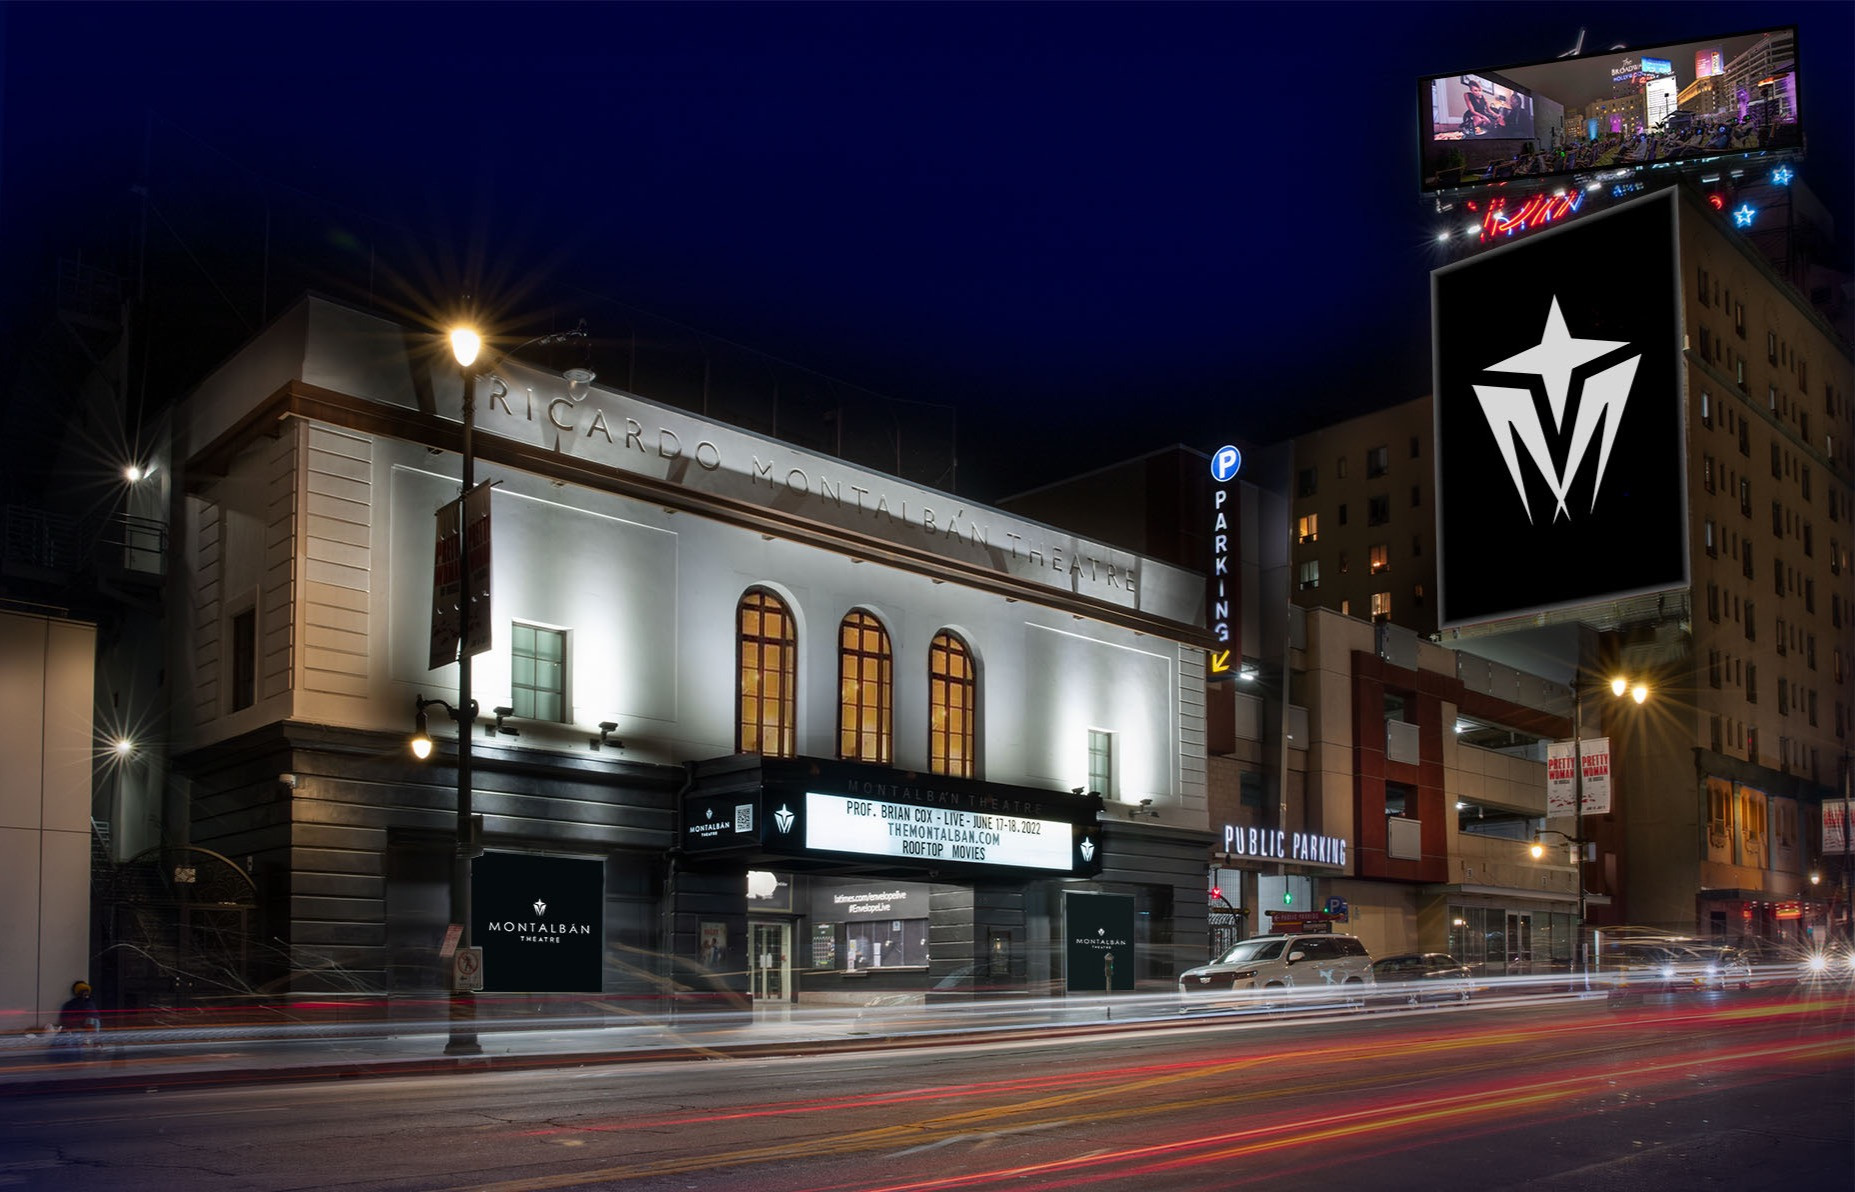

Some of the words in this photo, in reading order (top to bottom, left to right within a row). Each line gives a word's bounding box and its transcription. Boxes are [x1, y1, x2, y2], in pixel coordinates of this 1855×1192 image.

[489, 375, 721, 471] RICARDO
[751, 454, 988, 550] MONTALBÁN
[1006, 532, 1135, 592] THEATRE
[1214, 490, 1229, 642] PARKING
[1549, 757, 1575, 769] PRETTY
[1582, 754, 1608, 767] PRETTY
[1549, 769, 1574, 780] WOMAN
[1583, 765, 1608, 777] WOMAN
[969, 794, 1043, 815] THEATRE
[846, 800, 876, 817] PROF.
[881, 804, 910, 821] BRIAN
[914, 808, 933, 824] COX
[944, 812, 964, 827] LIVE
[973, 816, 993, 830] JUNE
[996, 818, 1041, 835] 17-18.2022
[888, 822, 1000, 846] THEMONTALBAN.COM
[902, 840, 944, 857] ROOFTOP
[952, 845, 986, 860] MOVIES
[1224, 825, 1285, 858] PUBLIC
[1293, 832, 1347, 865] PARKING
[488, 921, 591, 935] MONTALBÁN
